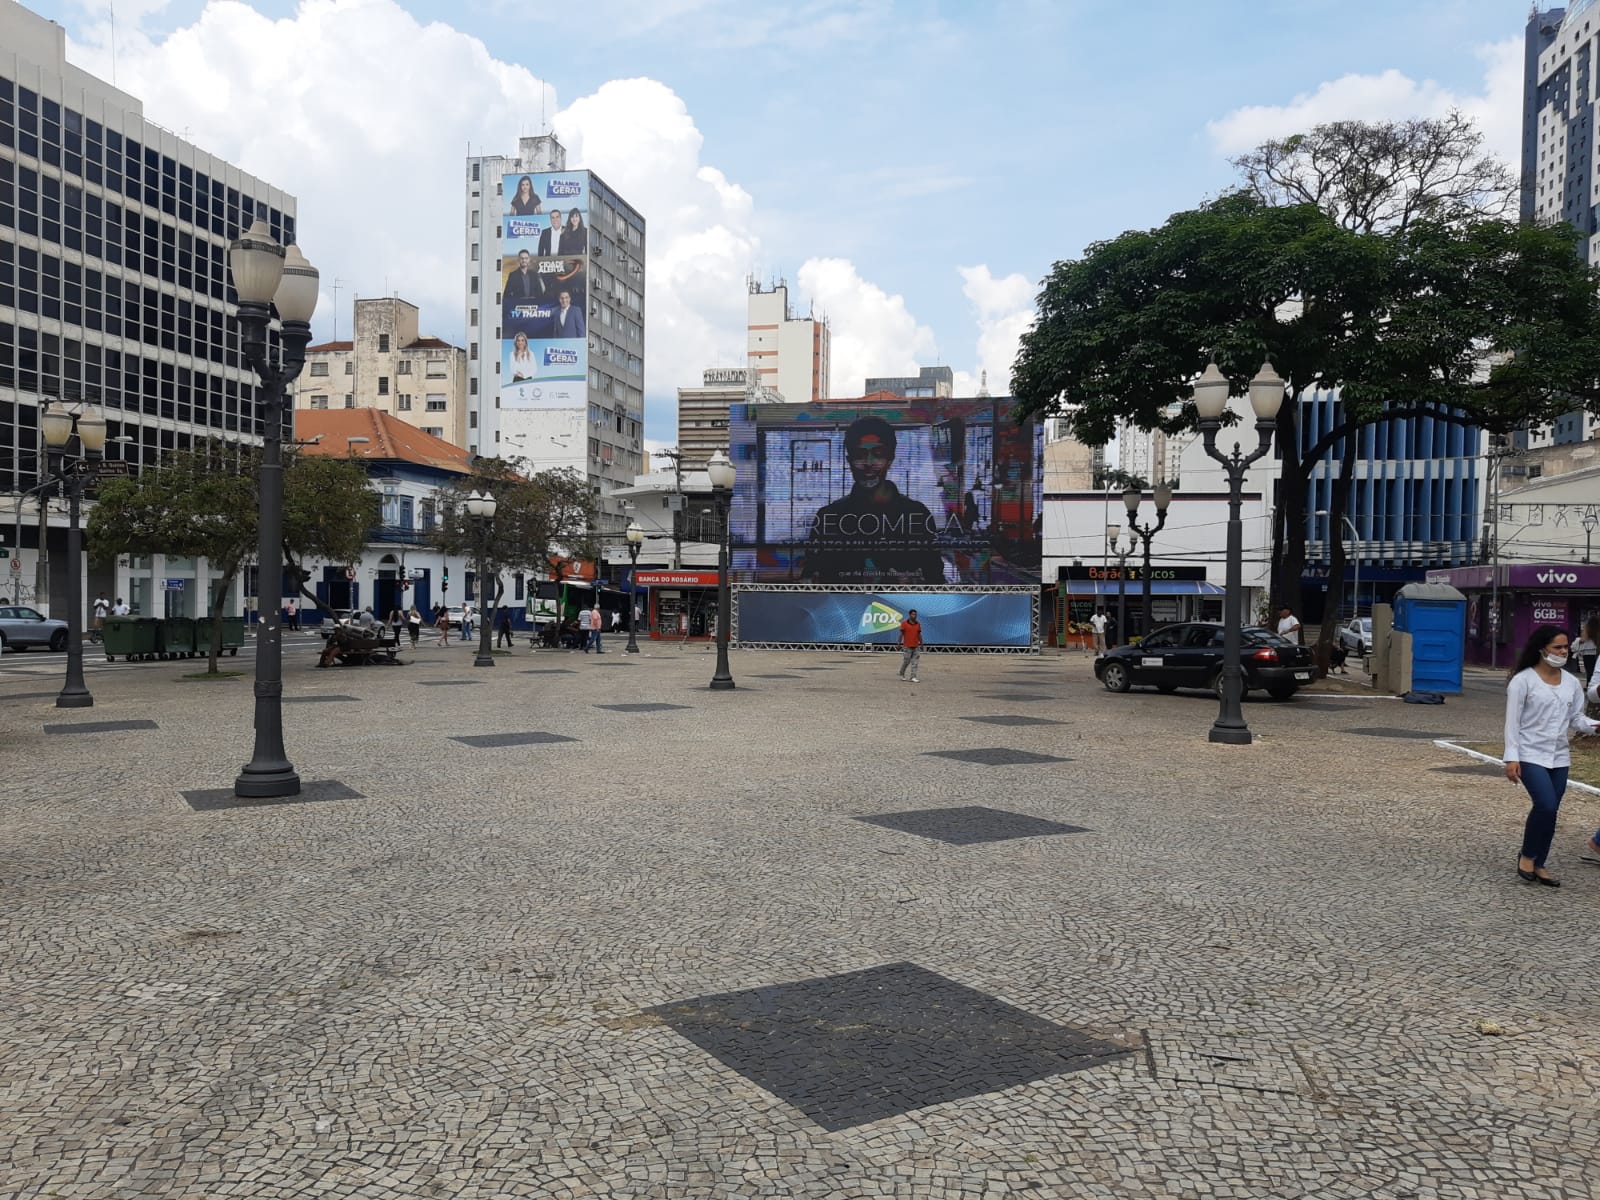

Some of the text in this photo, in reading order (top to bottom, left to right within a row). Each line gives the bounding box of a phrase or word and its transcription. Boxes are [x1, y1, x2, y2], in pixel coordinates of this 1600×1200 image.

[552, 186, 580, 194] GERAL
[512, 227, 539, 235] GERAL
[549, 354, 577, 362] GERAL
[803, 513, 964, 541] RECOMEÇA
[671, 575, 699, 583] ROSÁRIO
[1536, 569, 1577, 583] vivo
[1534, 608, 1557, 619] 6GB
[862, 610, 898, 627] prox
